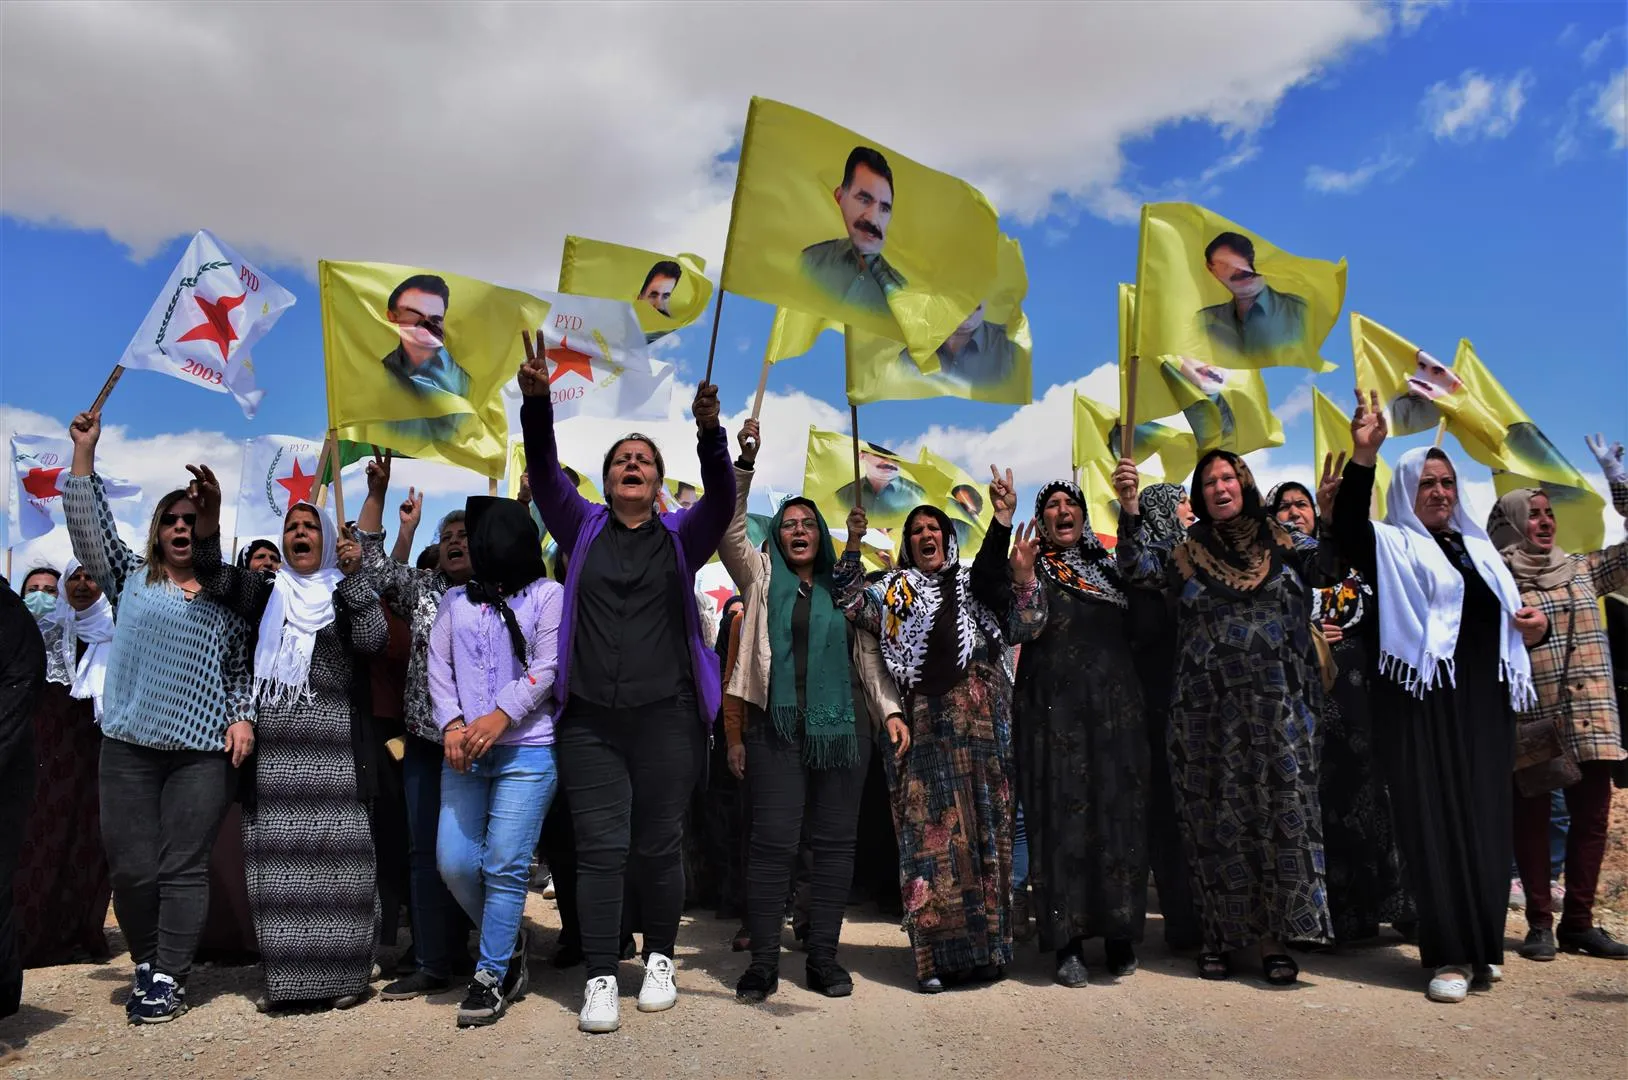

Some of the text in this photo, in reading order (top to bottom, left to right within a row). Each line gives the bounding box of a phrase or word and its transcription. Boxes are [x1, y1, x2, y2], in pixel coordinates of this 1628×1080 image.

[240, 265, 260, 292] PYD
[555, 314, 582, 331] PYD
[180, 358, 223, 385] 2003
[551, 386, 584, 405] 2003
